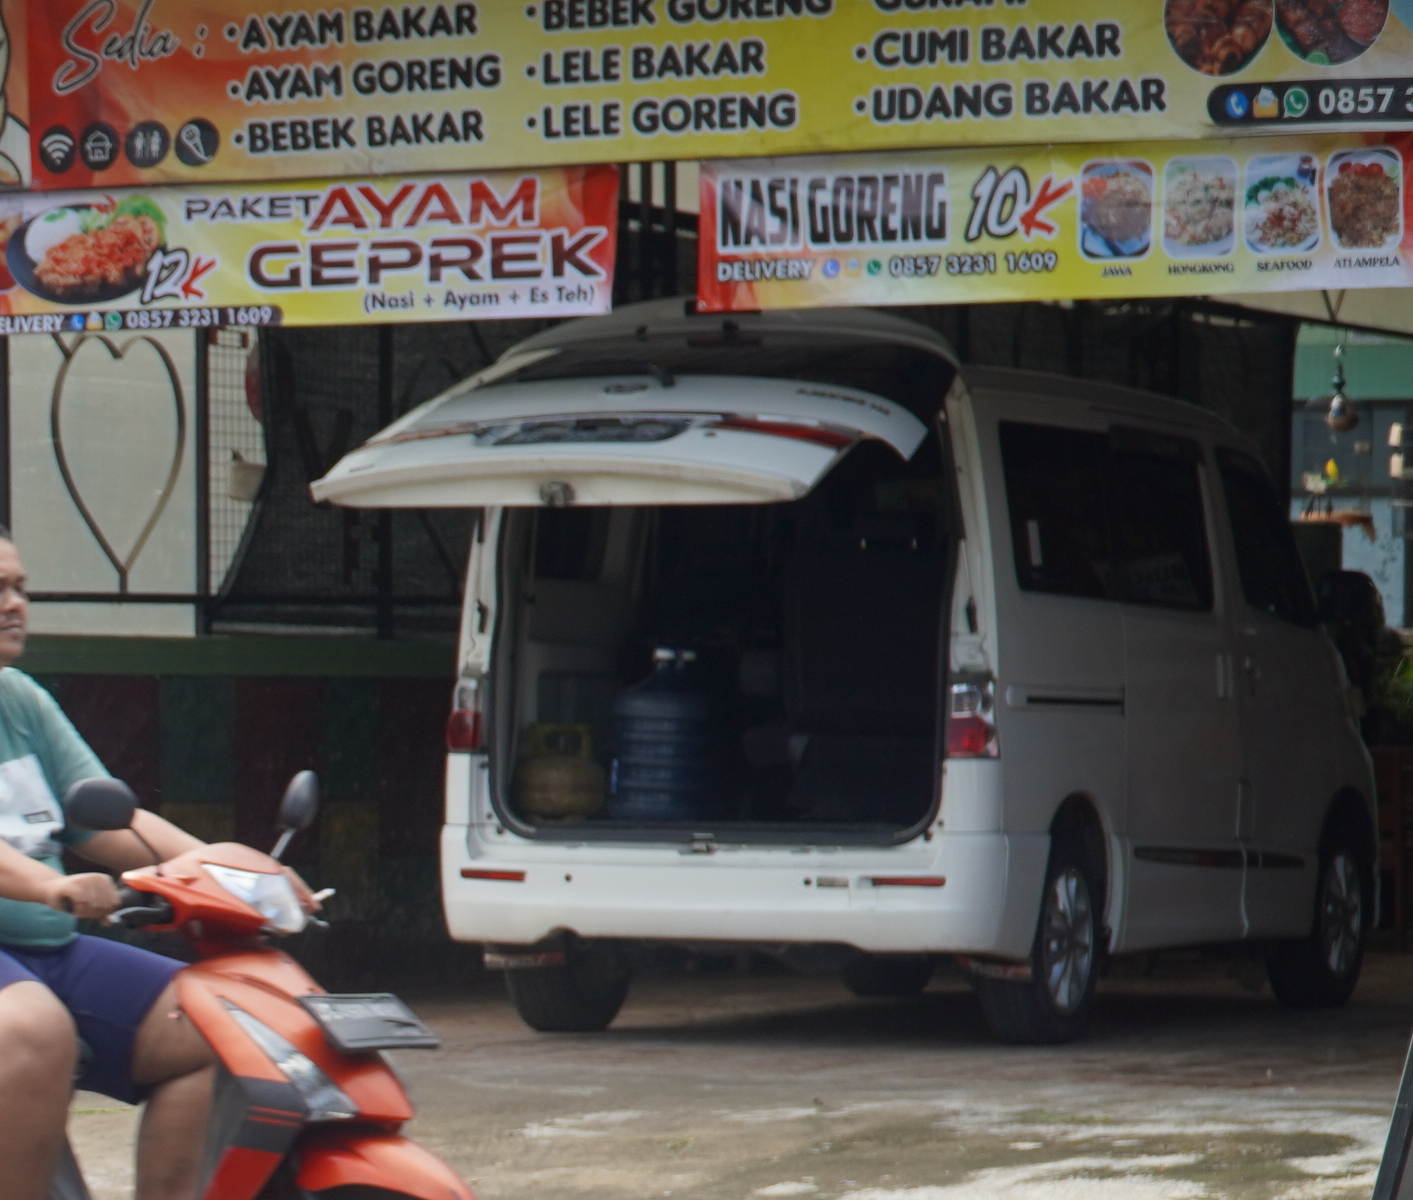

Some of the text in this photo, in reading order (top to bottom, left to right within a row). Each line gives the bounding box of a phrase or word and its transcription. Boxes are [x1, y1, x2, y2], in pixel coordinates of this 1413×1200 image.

[242, 3, 478, 49] AYAM BAKAR
[543, 0, 657, 30] BEBEK
[54, 0, 176, 94] Sedia
[543, 40, 765, 84] LELE BAKAR
[874, 24, 1121, 66] CUMI BAKAR
[245, 55, 501, 101] AYAM GORENG
[543, 93, 797, 138] LELE GORENG
[875, 78, 1166, 122] UDANG BAKAR
[1318, 86, 1394, 115] 0857
[249, 110, 484, 153] BEBEK BAKAR
[185, 178, 543, 232] PAKET AYAM
[720, 165, 1075, 249] NASI GORENG 10K
[141, 247, 217, 306] 12K
[250, 229, 609, 289] GEPREK
[717, 251, 1057, 282] DELIVERY 0857 3231 1609
[1101, 265, 1133, 278] JAWA
[1168, 261, 1235, 276] HONGKONG
[1256, 259, 1313, 273] SEAFOOD
[1353, 255, 1401, 269] AMPELA
[126, 309, 174, 329] 0857
[178, 307, 221, 327] 3231
[227, 305, 273, 325] 1609
[363, 289, 415, 316] (Nasi
[444, 288, 501, 311] Ayam
[529, 287, 550, 305] Es
[555, 283, 596, 305] Teh)
